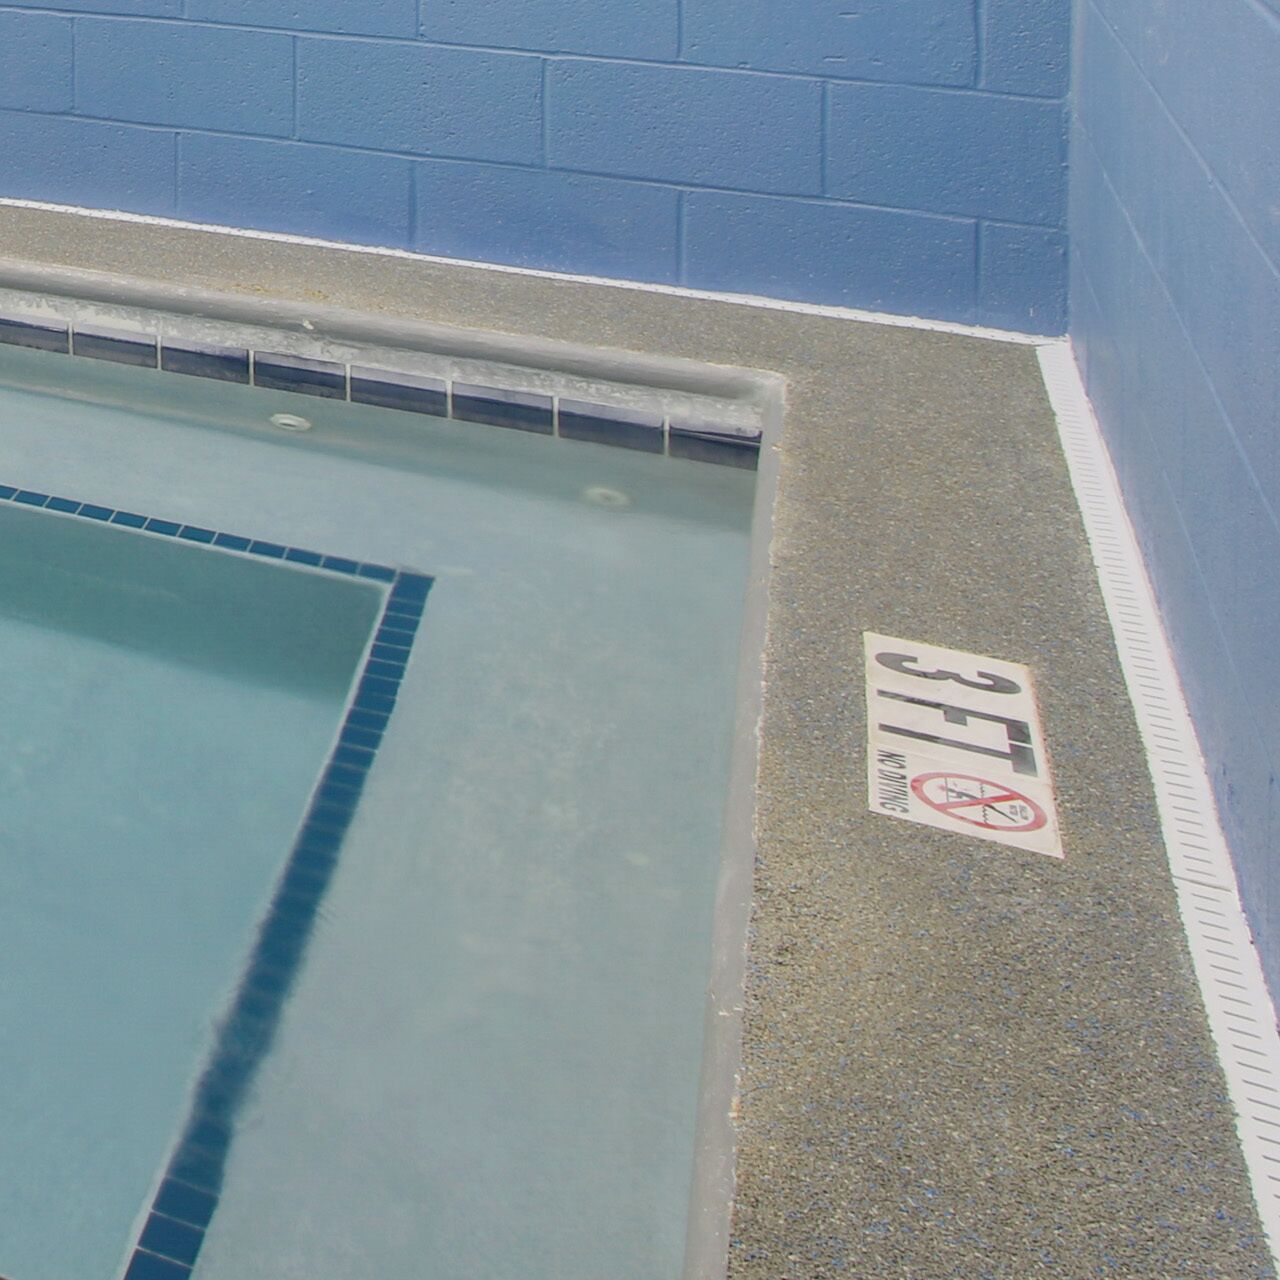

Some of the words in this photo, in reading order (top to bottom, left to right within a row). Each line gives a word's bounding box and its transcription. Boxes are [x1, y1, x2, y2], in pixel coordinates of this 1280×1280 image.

[874, 651, 1022, 695] 3
[876, 688, 1039, 778] FT
[877, 749, 907, 770] NO
[878, 768, 910, 814] DIVING
